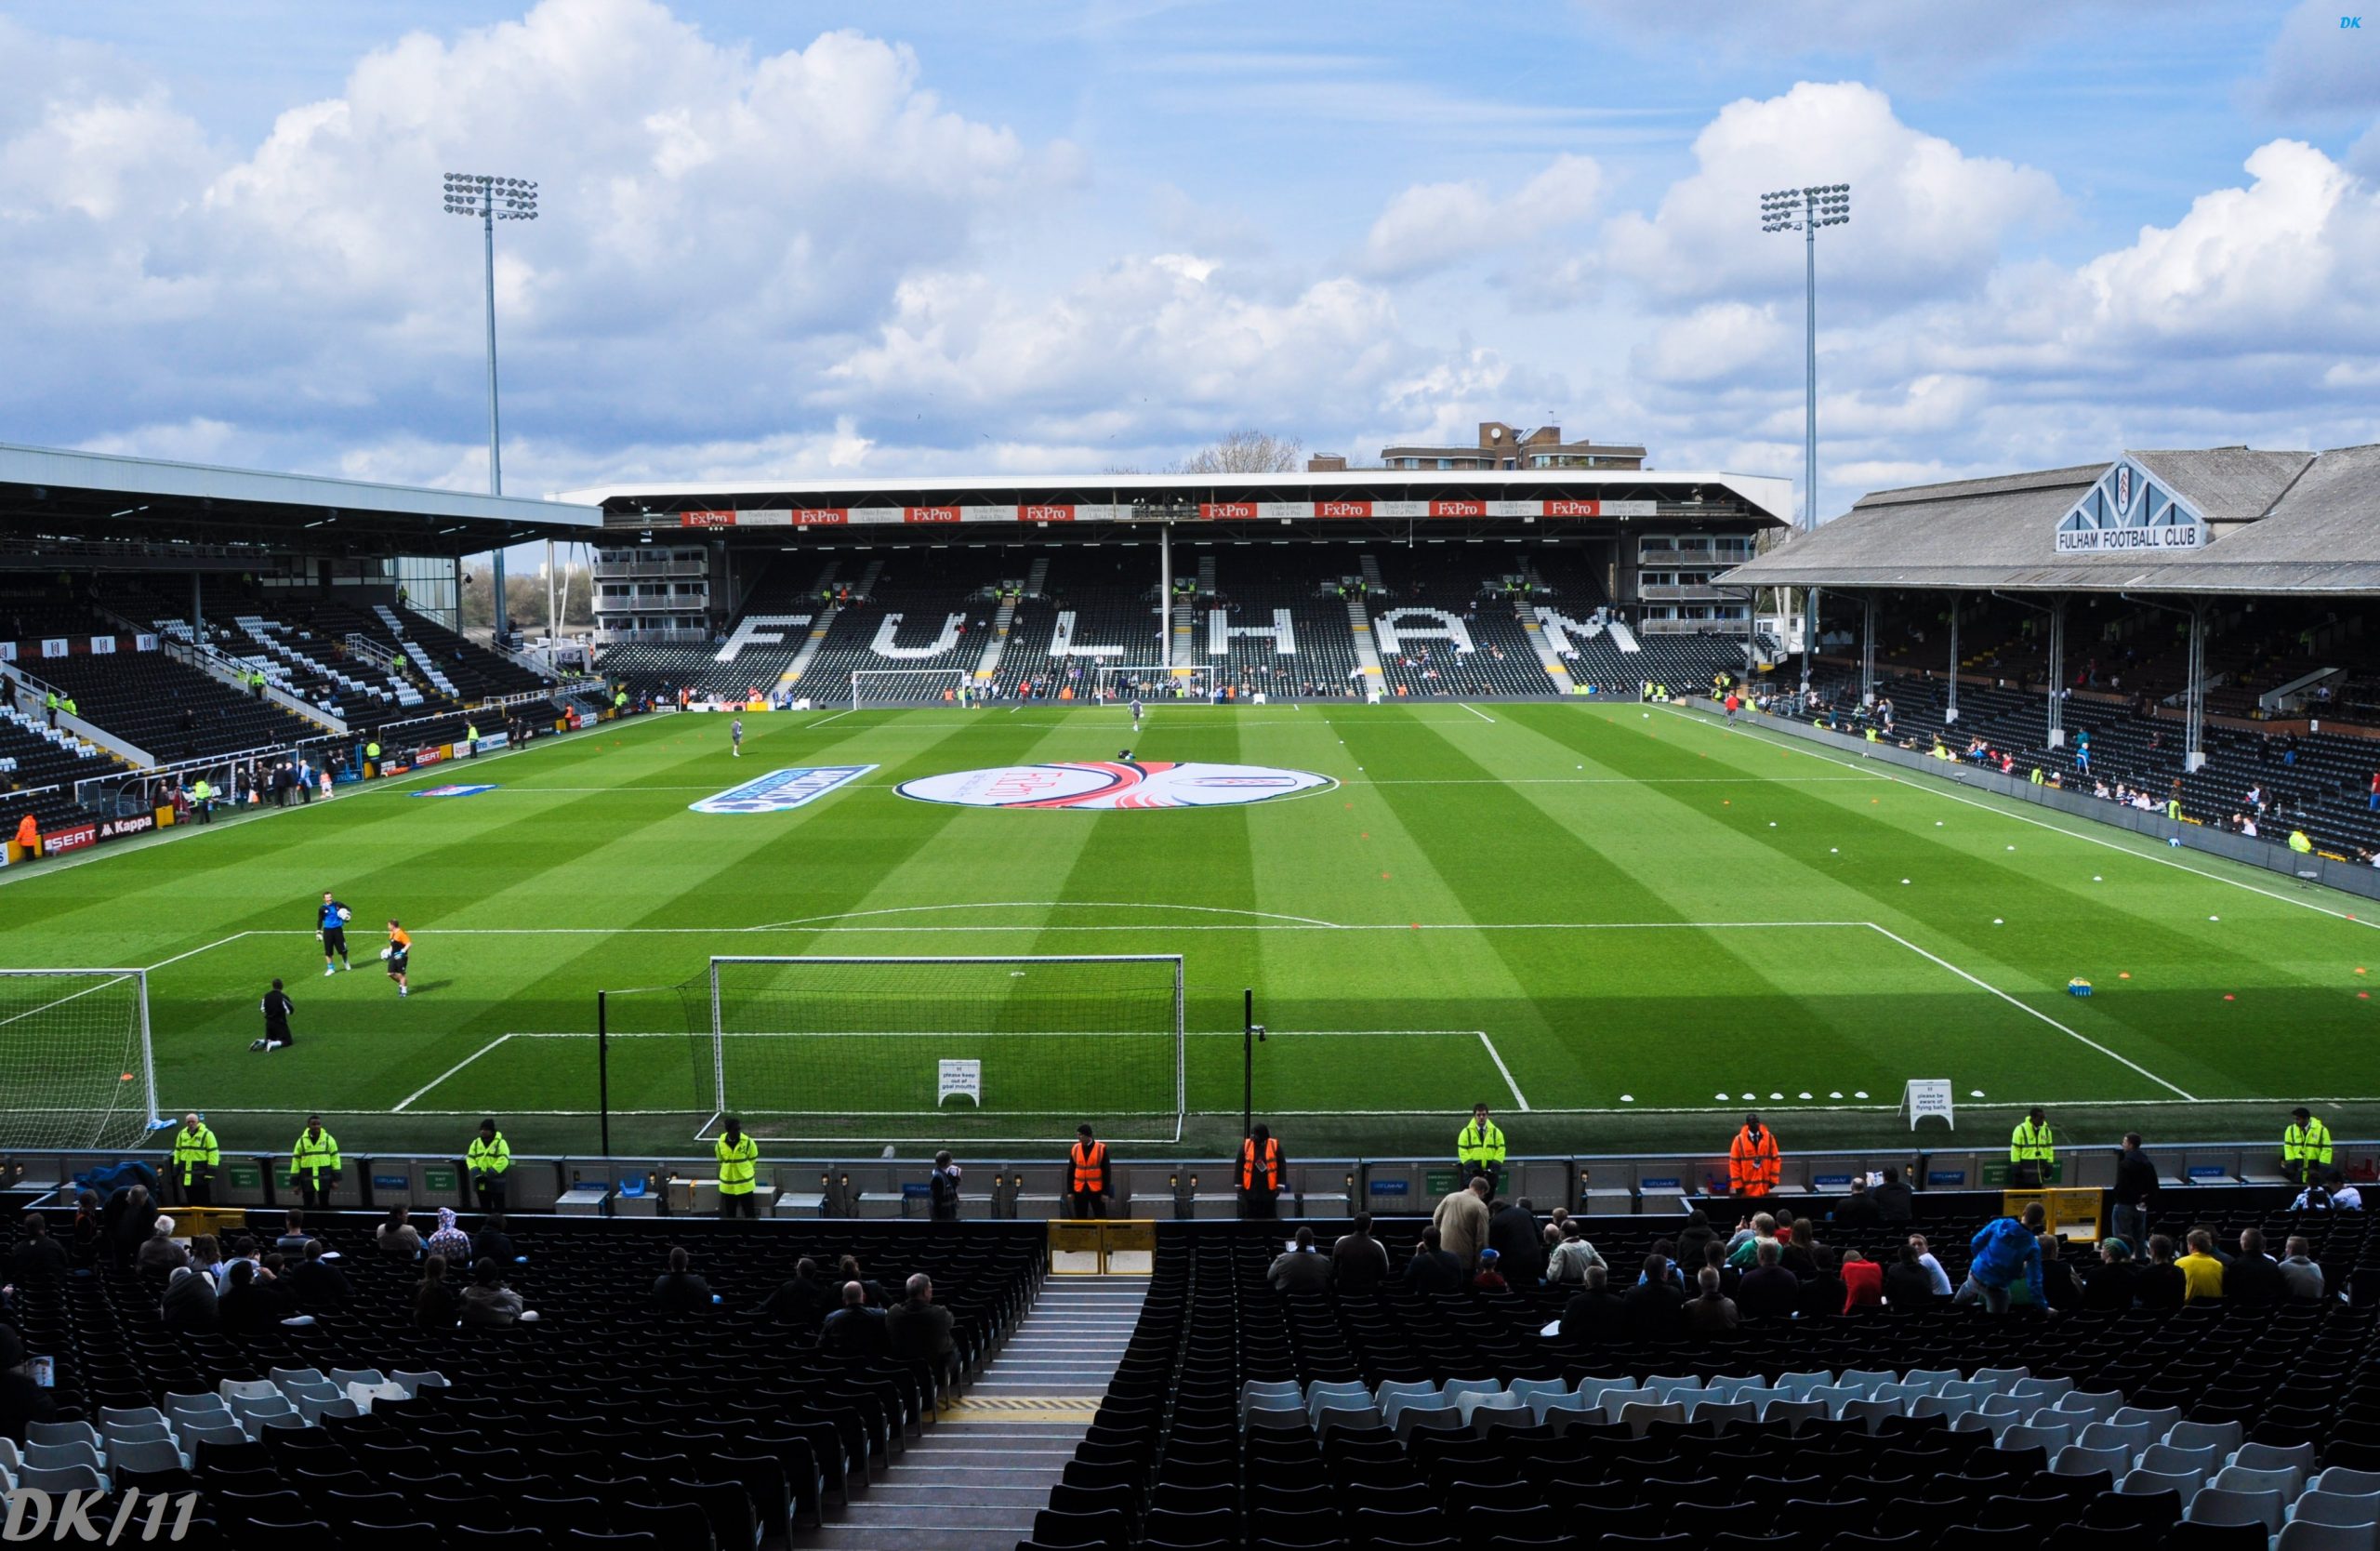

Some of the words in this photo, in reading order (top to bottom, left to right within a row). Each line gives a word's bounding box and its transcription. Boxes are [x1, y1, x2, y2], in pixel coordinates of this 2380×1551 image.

[913, 508, 952, 521] FxPro
[1027, 506, 1065, 519] FxPro
[1210, 504, 1249, 517] FxPro
[1324, 503, 1363, 516] FxPro
[1439, 502, 1477, 515] FxPro
[1552, 502, 1591, 514] FxPro
[800, 510, 840, 523] FxPro
[2059, 532, 2098, 549] FULHAM
[2104, 527, 2159, 548] FOOTBALL
[2165, 527, 2196, 546] CLUB
[418, 750, 441, 763] SEAT
[114, 816, 152, 833] Kappa
[52, 829, 96, 849] SEAT
